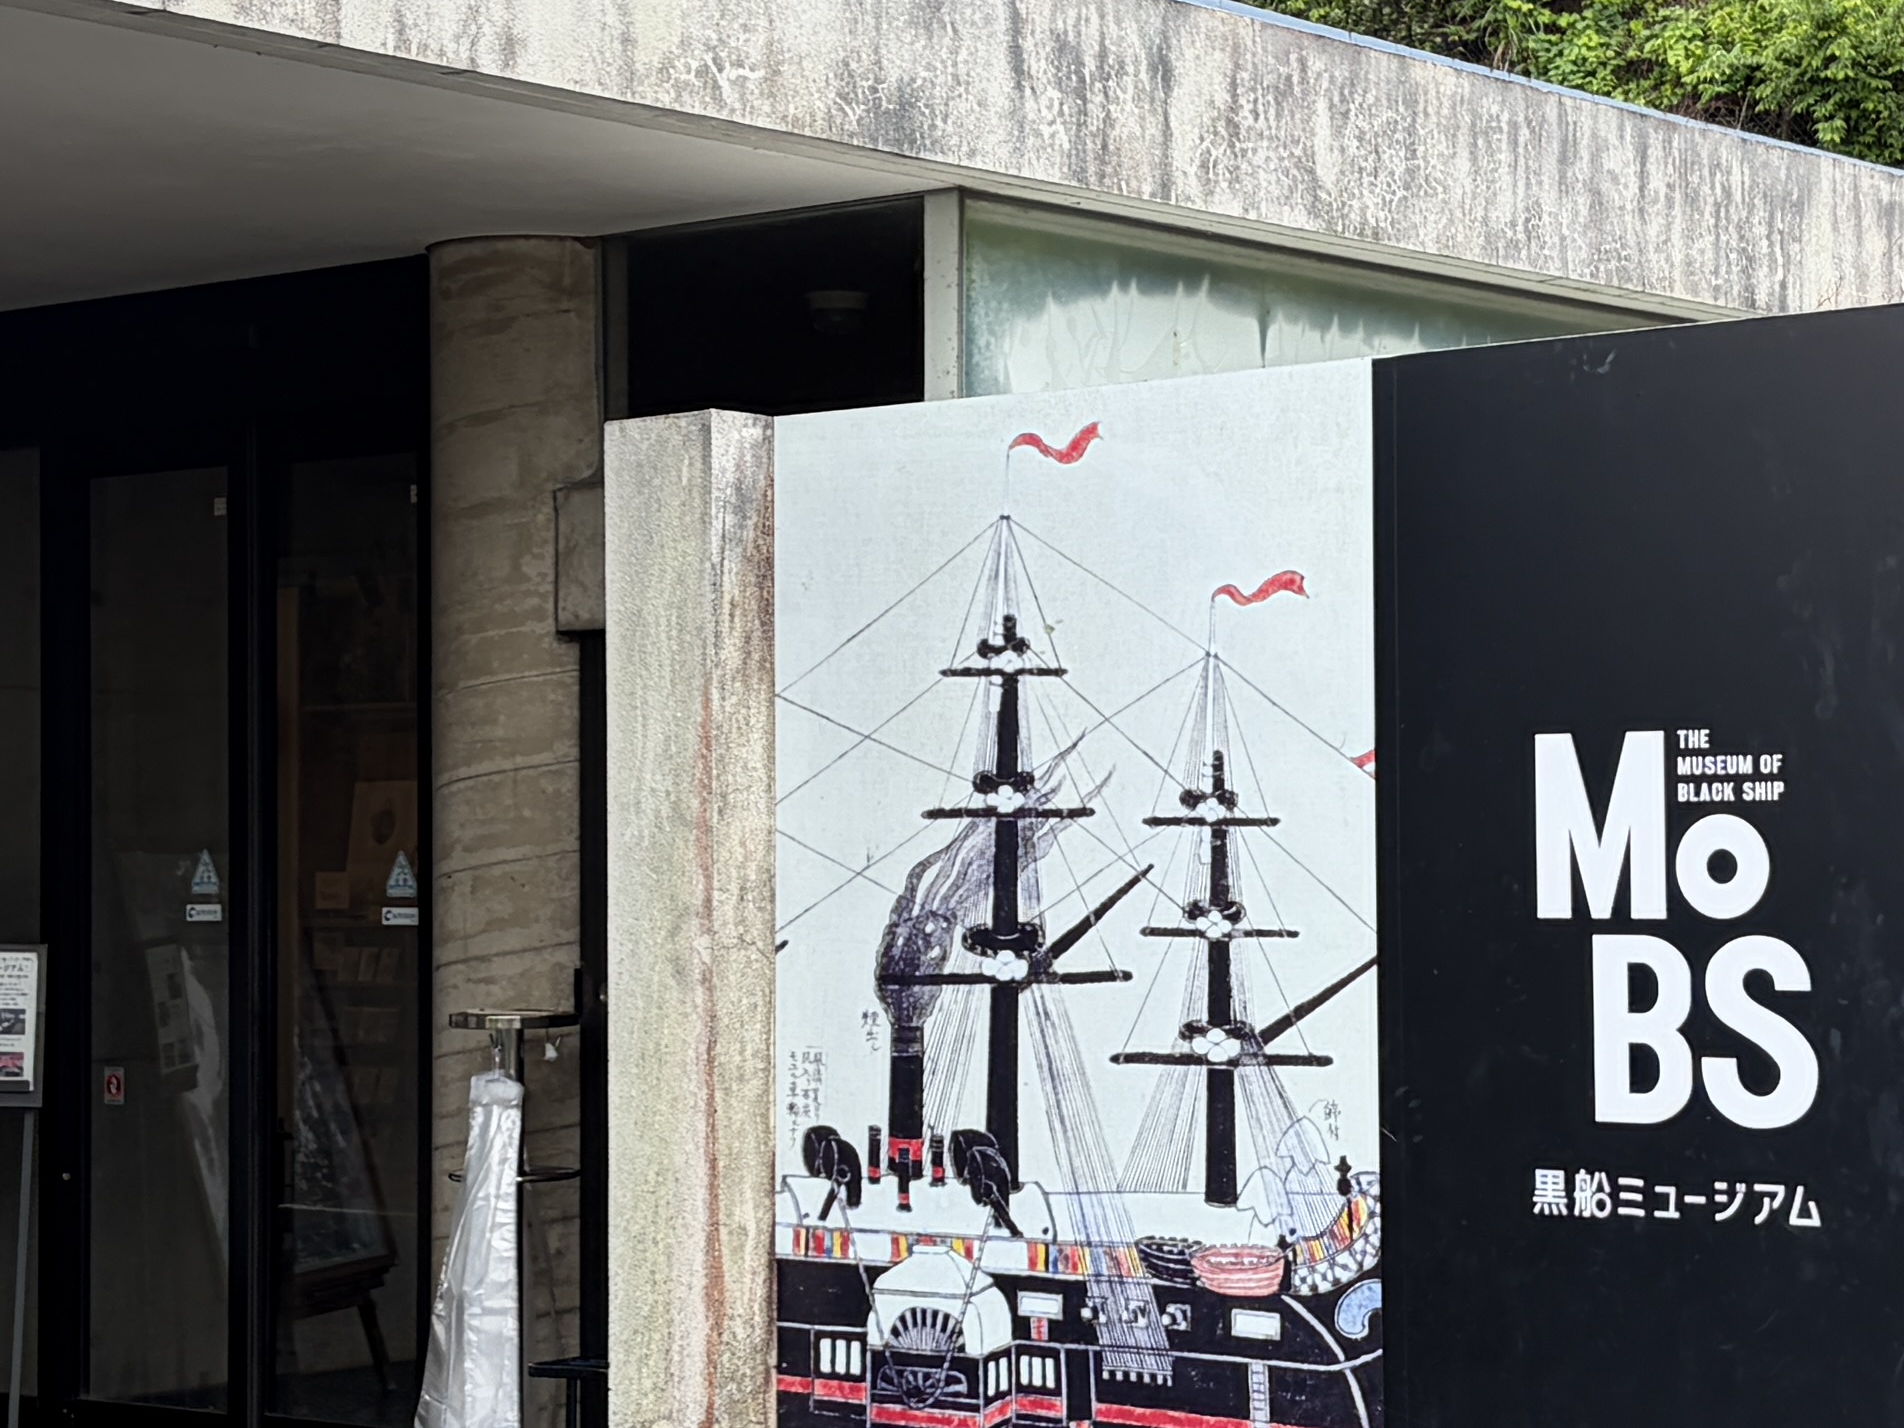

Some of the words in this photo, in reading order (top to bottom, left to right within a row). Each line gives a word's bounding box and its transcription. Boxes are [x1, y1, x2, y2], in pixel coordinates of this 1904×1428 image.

[1677, 729, 1710, 749] THE
[1677, 755, 1753, 775] MUSEUM
[1760, 754, 1783, 774] OF
[1677, 782, 1735, 802] BLACK
[1742, 781, 1785, 801] SHIP
[1534, 730, 1770, 920] Mo
[1591, 934, 1819, 1130] BS
[1533, 1168, 1822, 1228] 黒船ミュージアム
